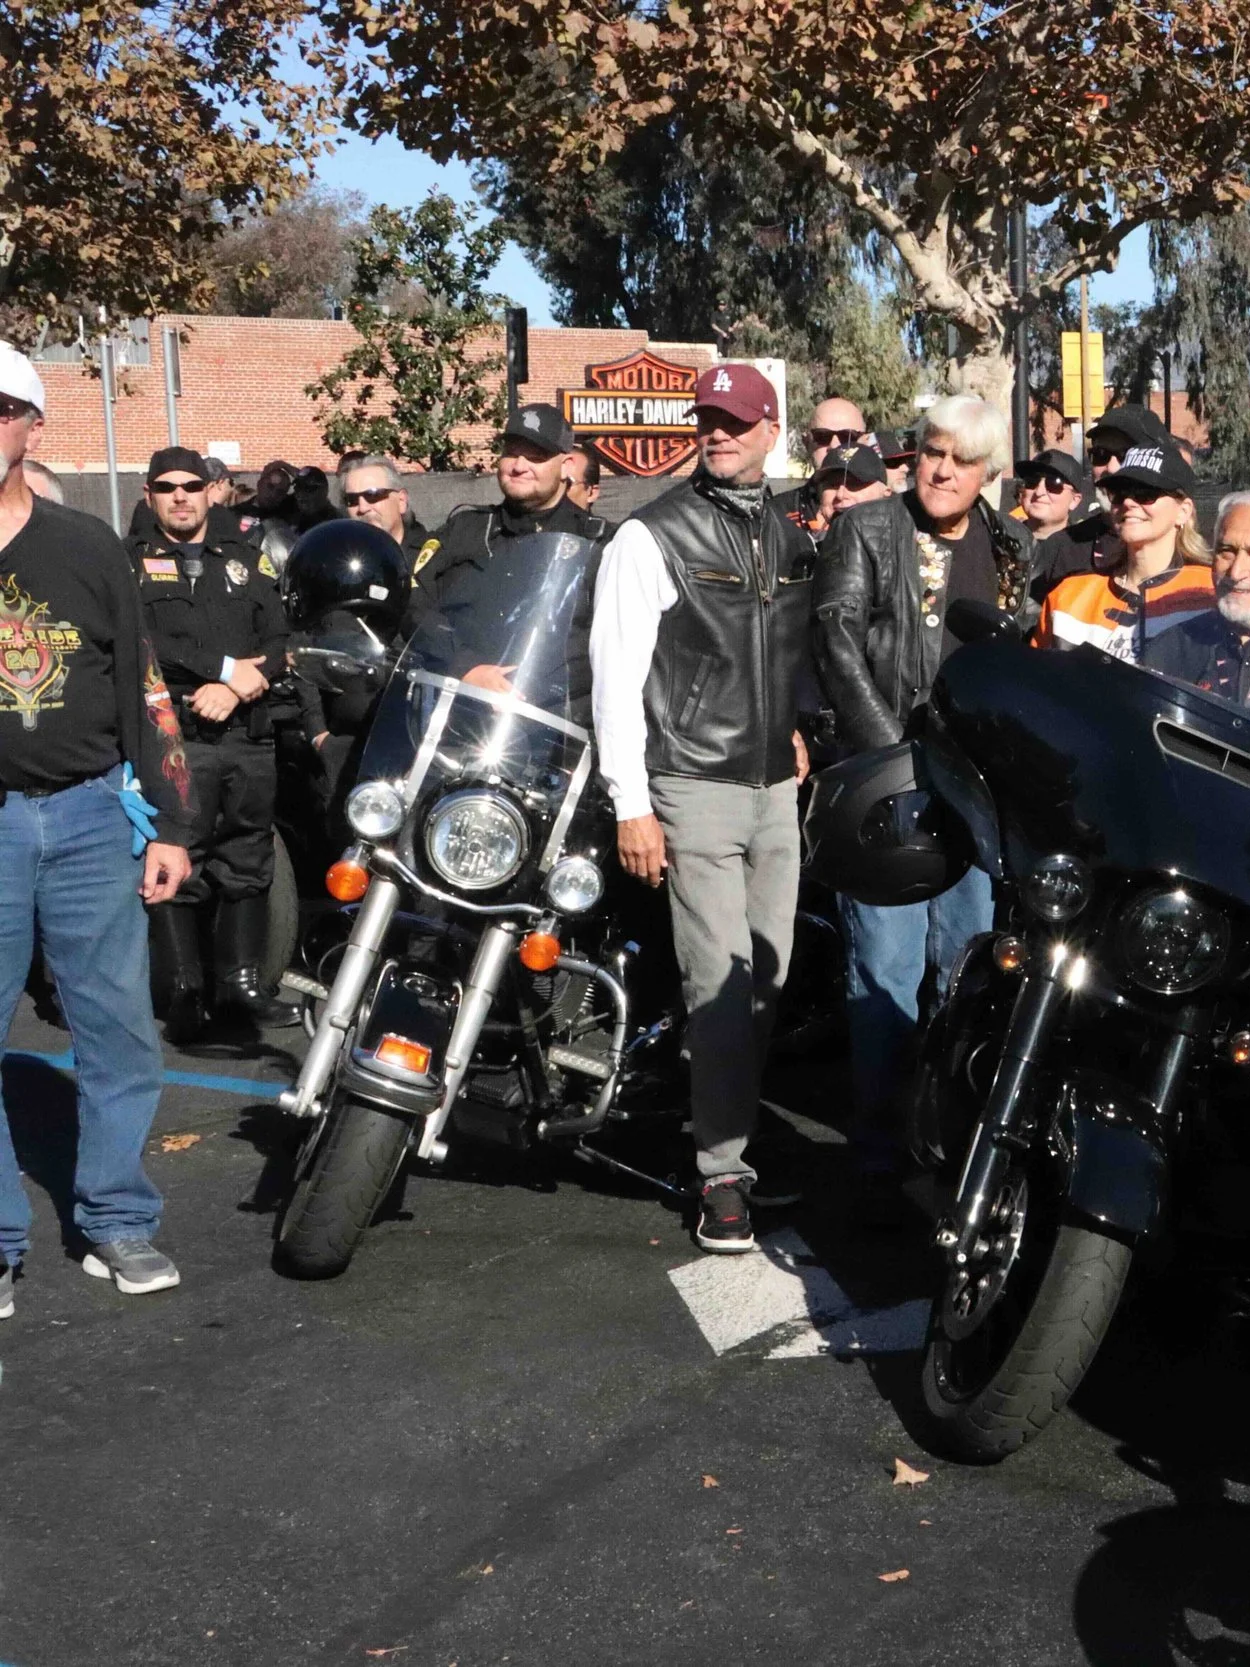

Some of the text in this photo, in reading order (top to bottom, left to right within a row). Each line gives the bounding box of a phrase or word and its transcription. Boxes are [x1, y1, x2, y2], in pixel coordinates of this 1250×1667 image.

[607, 361, 685, 390] MOTOR
[713, 369, 733, 392] LA
[573, 397, 698, 426] HARLEY-DAVIDS
[608, 437, 685, 470] CYCLES
[5, 648, 40, 670] 24
